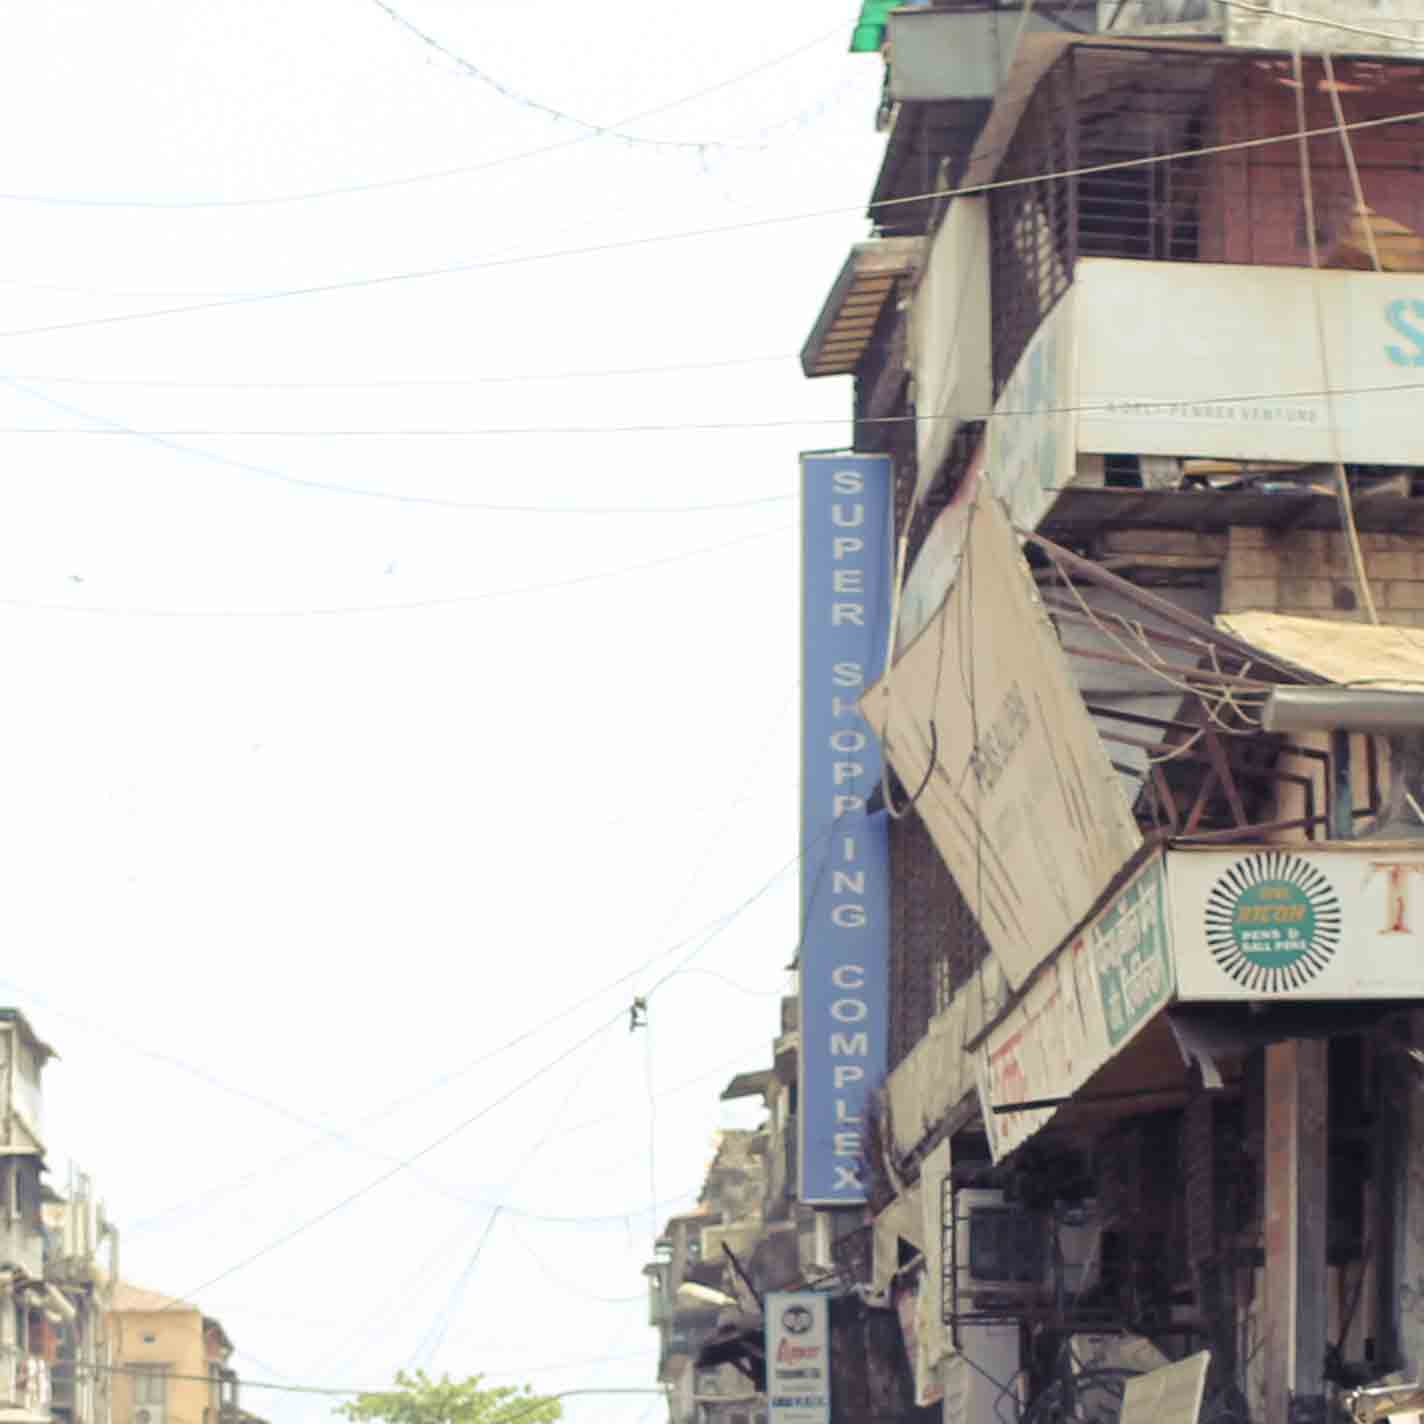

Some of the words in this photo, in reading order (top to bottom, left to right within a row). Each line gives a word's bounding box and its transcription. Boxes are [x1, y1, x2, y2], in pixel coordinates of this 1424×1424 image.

[830, 470, 865, 626] SUPER
[829, 662, 867, 926] SHOPPING
[829, 964, 868, 1191] COMPLEX
